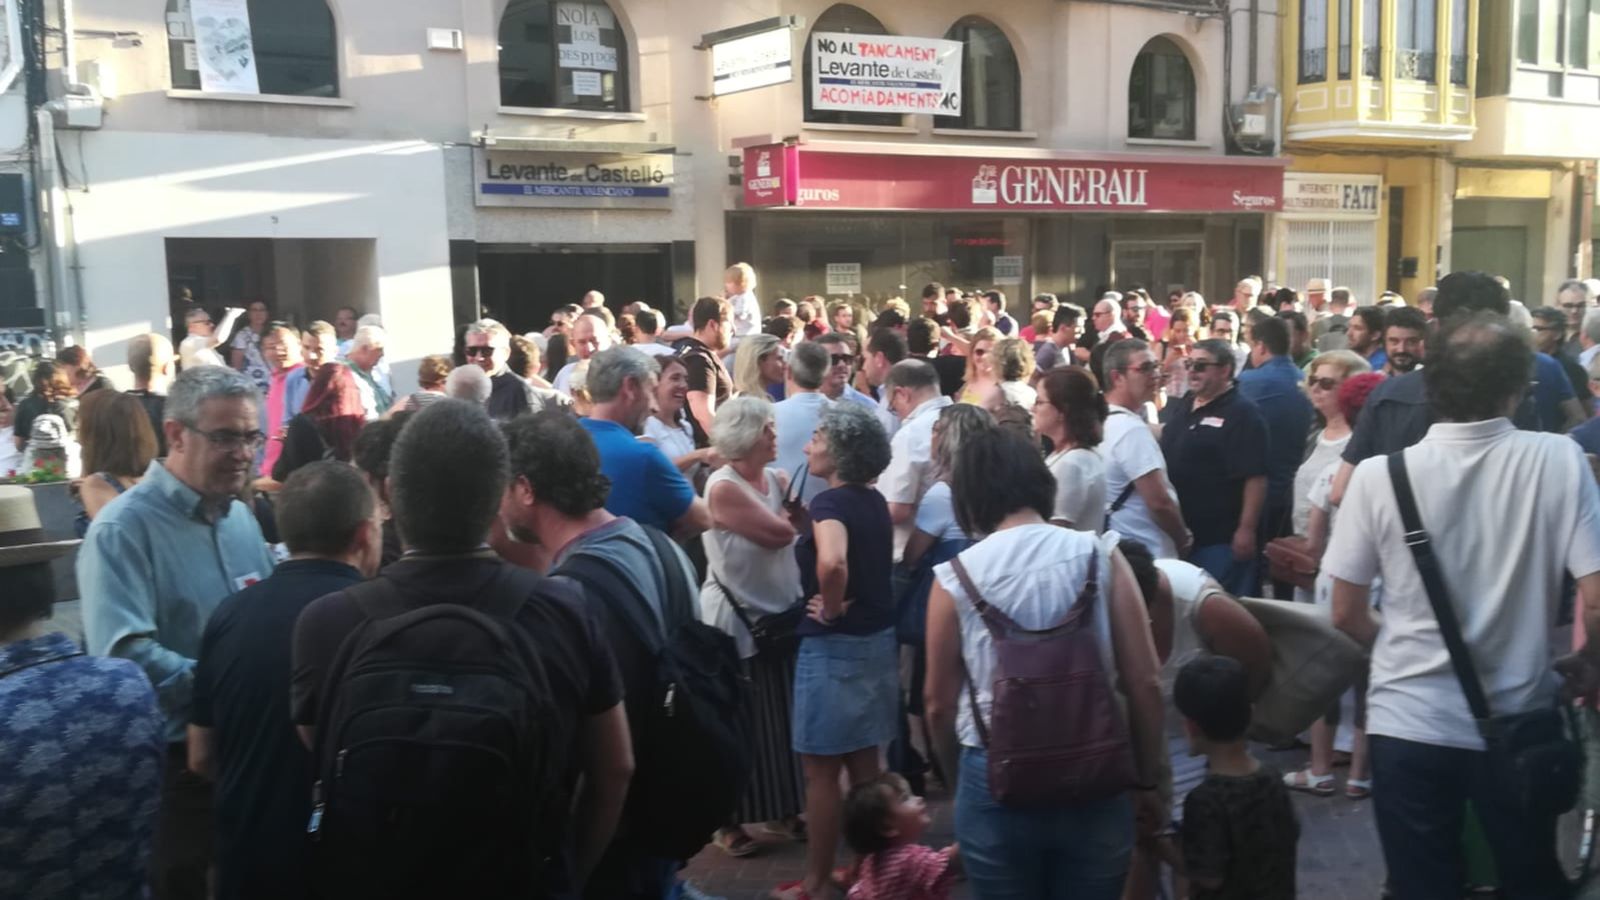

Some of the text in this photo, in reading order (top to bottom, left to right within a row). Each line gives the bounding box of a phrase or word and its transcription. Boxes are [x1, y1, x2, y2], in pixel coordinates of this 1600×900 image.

[573, 30, 596, 41] LOS
[817, 38, 937, 61] NO AL TANCAMENT
[818, 56, 890, 78] Levante
[891, 68, 905, 78] de
[486, 159, 568, 182] Levante
[585, 163, 665, 184] Castelló
[1000, 165, 1148, 206] GENERALI
[1297, 183, 1332, 194] INTERNET
[1232, 190, 1276, 209] Seguros
[1283, 197, 1340, 209] ULTISERVICIOS
[1342, 184, 1379, 210] FATI
